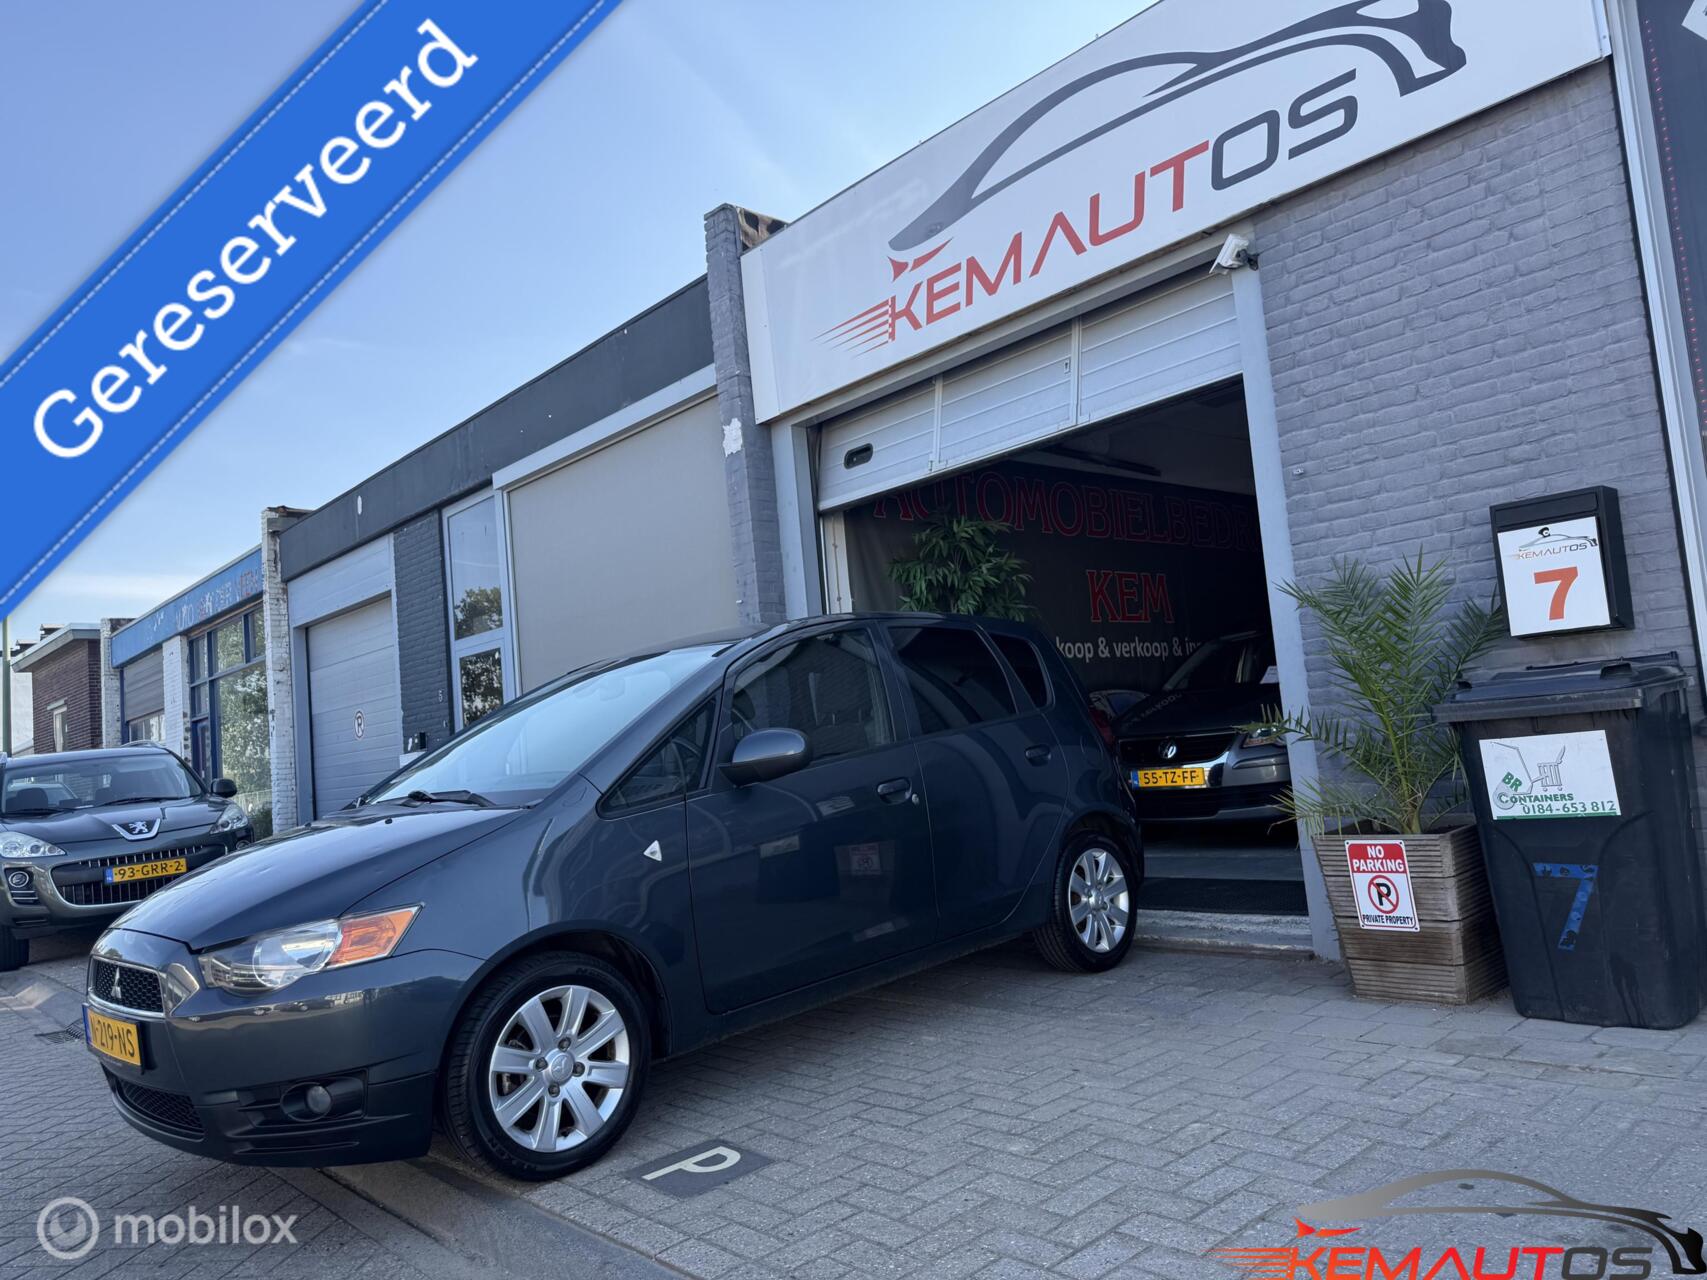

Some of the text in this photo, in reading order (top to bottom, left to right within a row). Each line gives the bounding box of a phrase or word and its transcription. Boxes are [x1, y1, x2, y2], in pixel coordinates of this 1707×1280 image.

[888, 67, 1358, 342] KEMAUTOS
[1518, 542, 1588, 560] KEMAUTOS
[1086, 569, 1176, 624] KEM
[1533, 565, 1579, 621] 7
[1097, 636, 1111, 658] &
[1112, 636, 1169, 661] verkoop
[1171, 636, 1183, 657] &
[1143, 769, 1198, 785] 55-TZ-FF
[1502, 771, 1523, 792] BR
[1523, 800, 1617, 815] 0184-653 812
[1367, 845, 1385, 858] NO
[118, 860, 182, 879] 93-GRR-2
[1353, 859, 1405, 871] PARKING
[1532, 862, 1599, 950] 7
[1362, 914, 1413, 925] PRIVATE PROPERTY
